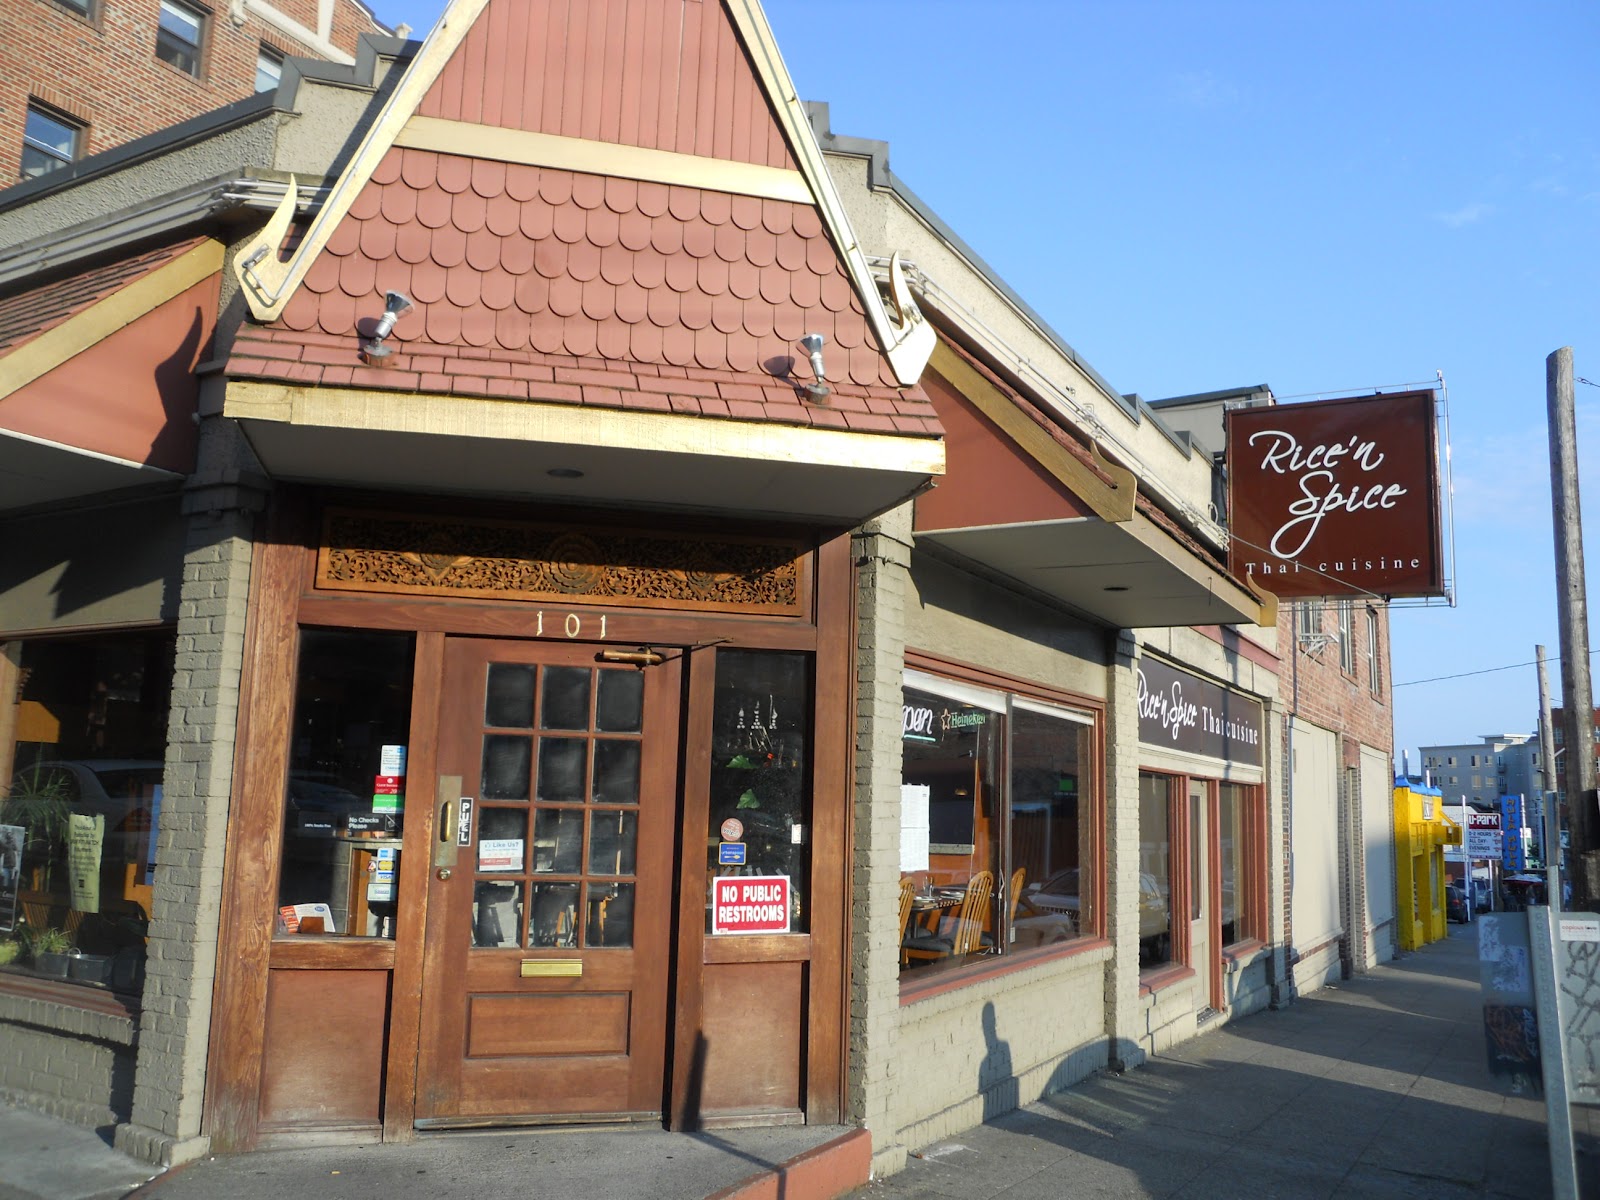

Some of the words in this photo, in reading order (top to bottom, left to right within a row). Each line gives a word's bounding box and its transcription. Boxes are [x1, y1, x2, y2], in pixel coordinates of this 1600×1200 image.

[1249, 430, 1384, 473] Rice'n
[1270, 470, 1407, 559] Spice
[1245, 560, 1300, 574] Thai
[1319, 556, 1420, 571] cuisine
[536, 610, 606, 640] 101
[902, 705, 932, 735] pen
[950, 712, 986, 729] Heineken
[1169, 681, 1198, 741] Spice
[1202, 706, 1225, 736] Thai
[1225, 717, 1258, 745] cuisine
[358, 816, 379, 824] Checks
[722, 887, 738, 902] NO
[743, 885, 782, 902] PUBLIC
[718, 904, 784, 923] RESTROOMS
